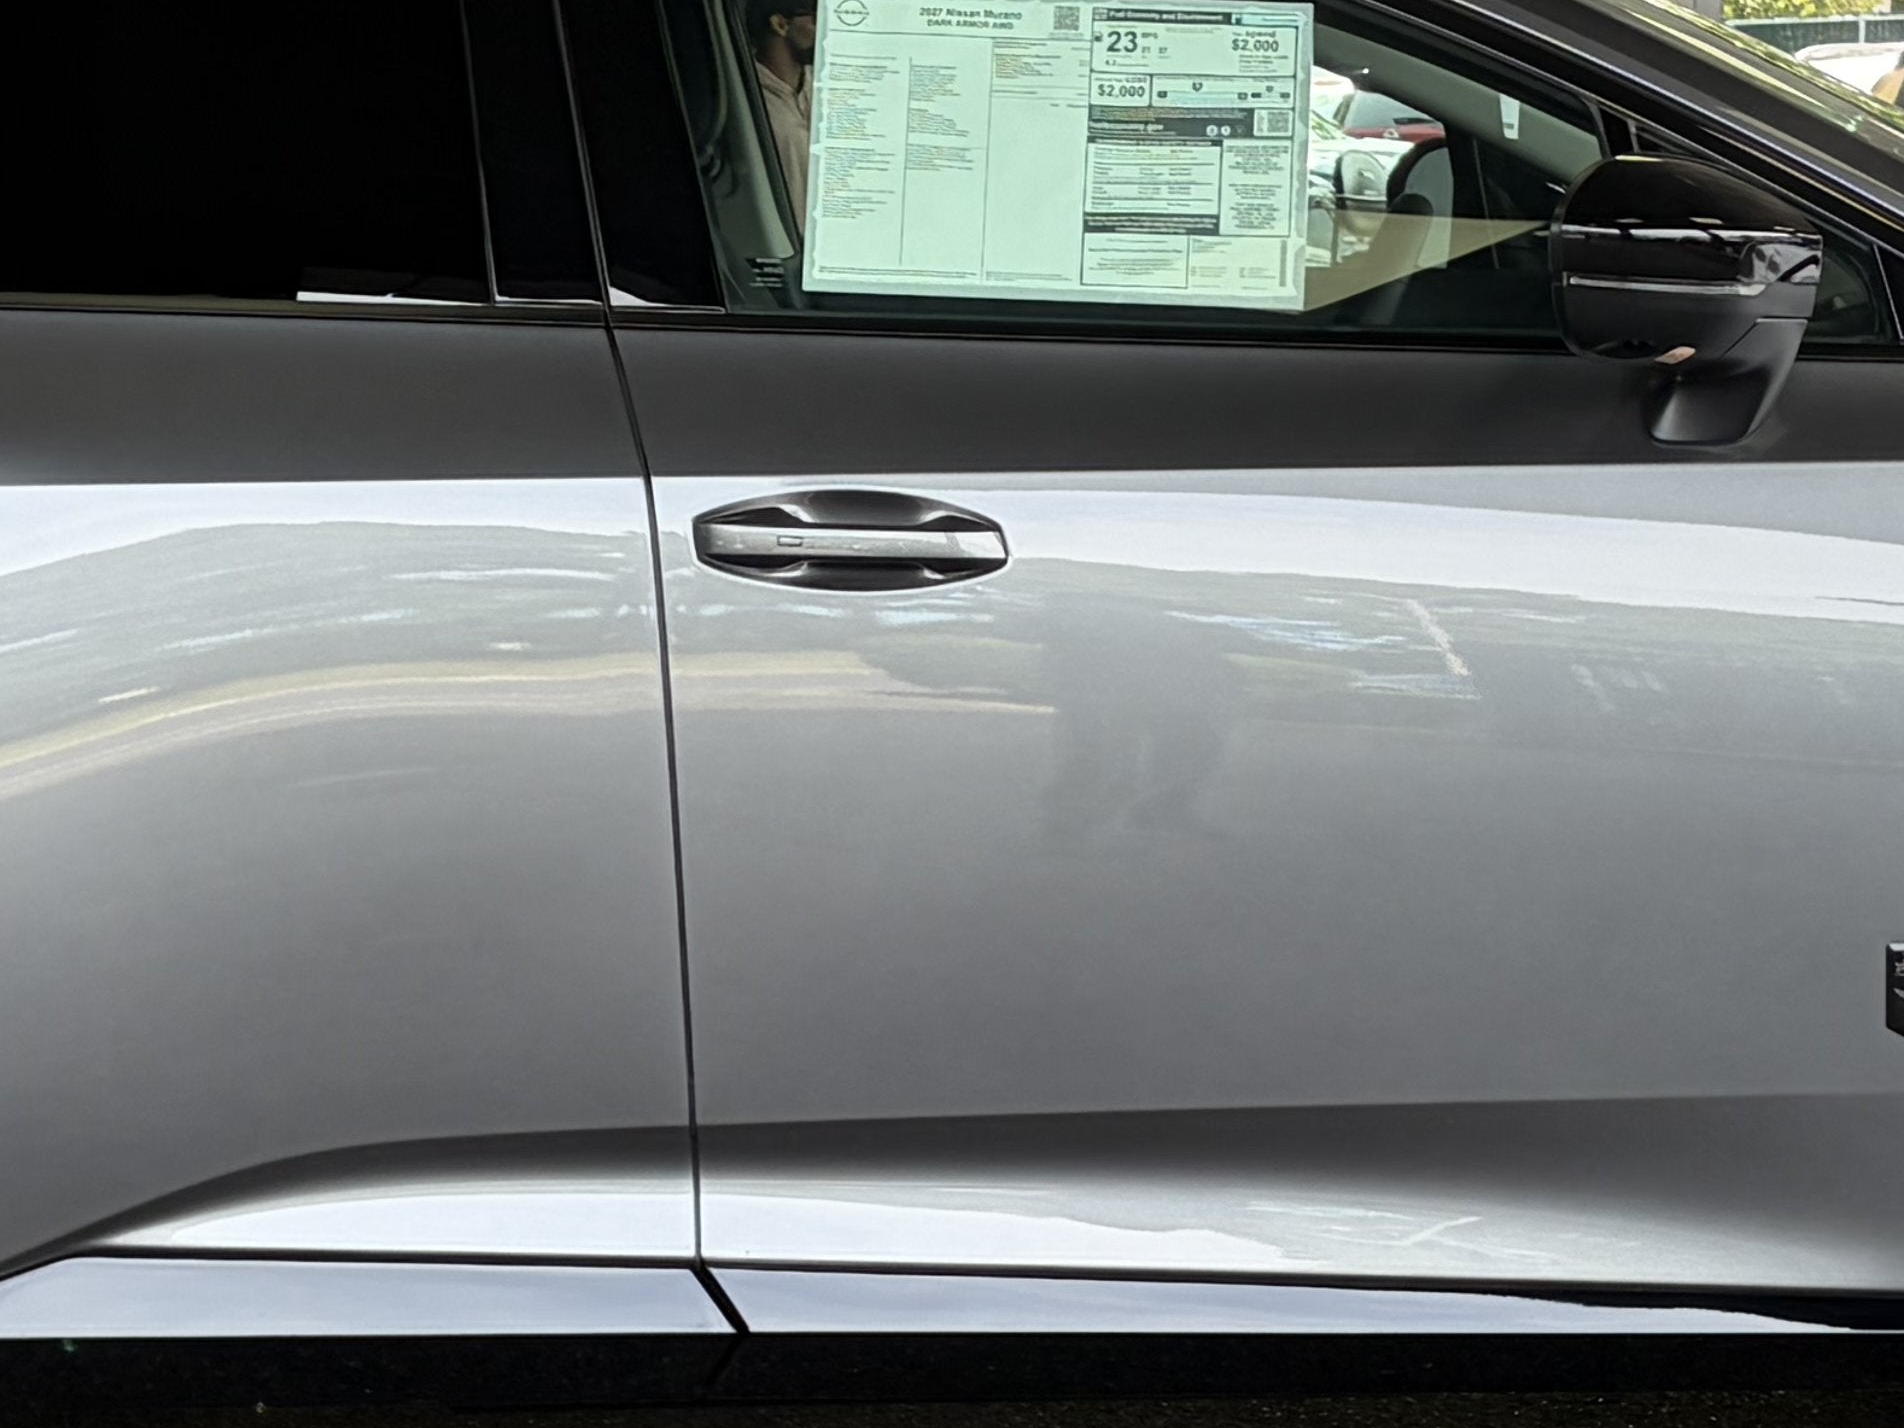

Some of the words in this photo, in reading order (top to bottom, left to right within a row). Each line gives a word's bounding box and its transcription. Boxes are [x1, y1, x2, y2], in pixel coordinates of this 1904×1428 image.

[1106, 30, 1138, 53] 23
[1231, 38, 1280, 53] $2,000
[1098, 84, 1146, 98] $2,000
